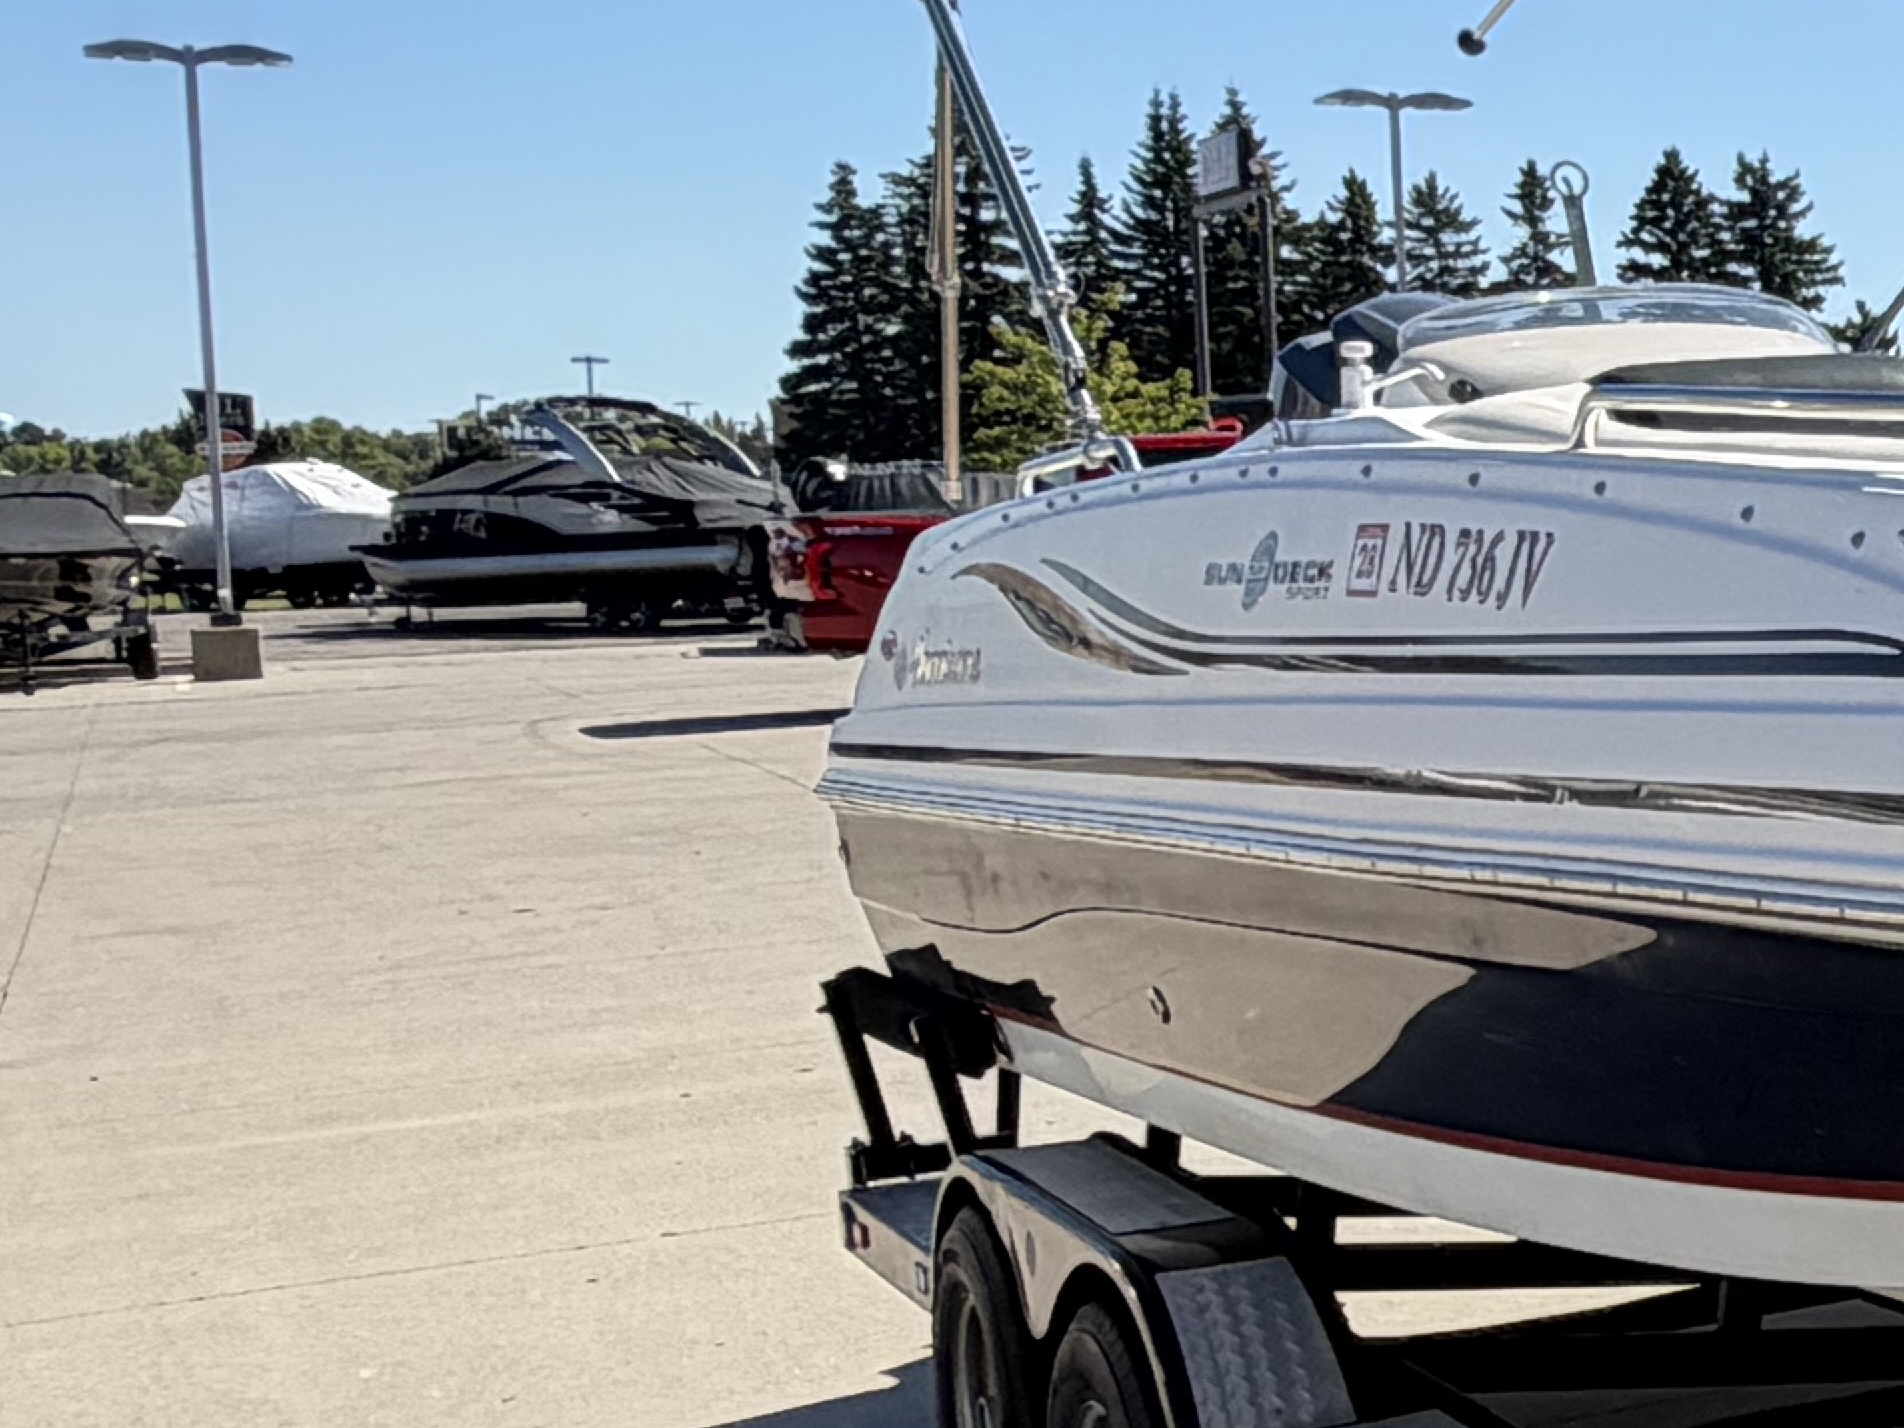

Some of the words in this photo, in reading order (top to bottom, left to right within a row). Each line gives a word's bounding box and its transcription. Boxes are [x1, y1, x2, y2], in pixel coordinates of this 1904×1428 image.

[1272, 558, 1334, 586] DECK
[1388, 521, 1446, 597] ND
[1447, 527, 1505, 605] 736
[1495, 529, 1555, 611] JV
